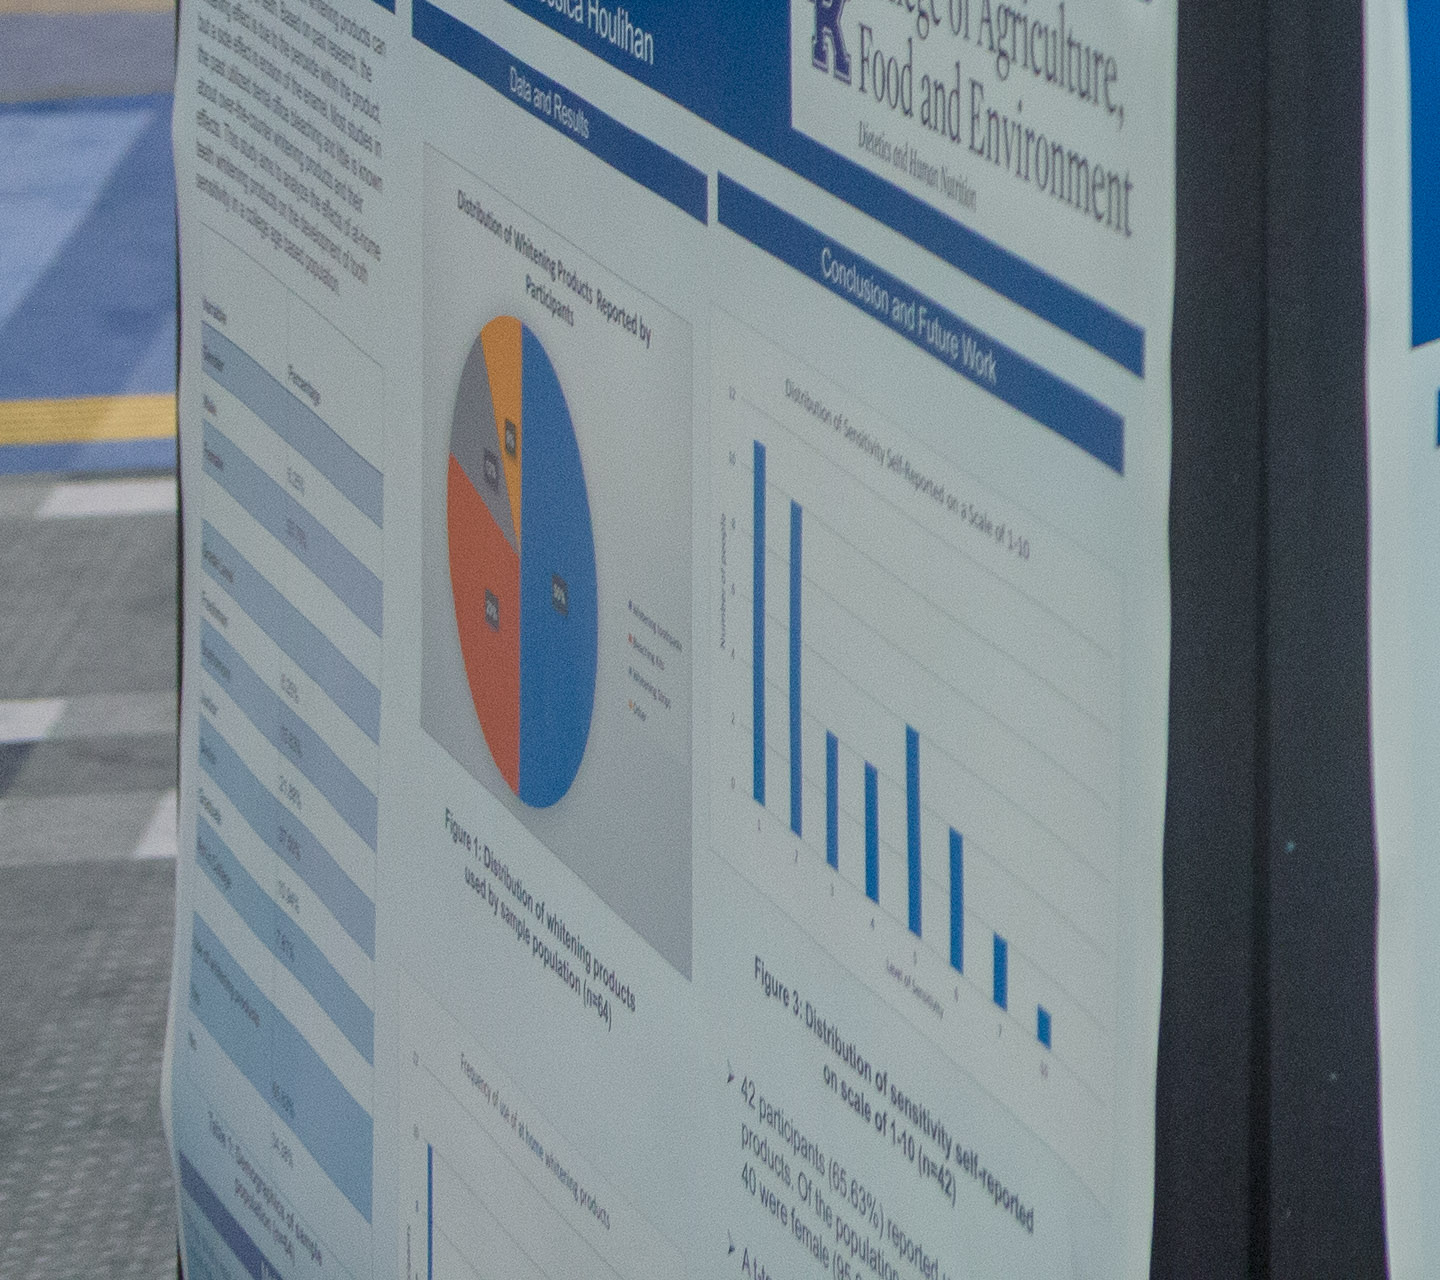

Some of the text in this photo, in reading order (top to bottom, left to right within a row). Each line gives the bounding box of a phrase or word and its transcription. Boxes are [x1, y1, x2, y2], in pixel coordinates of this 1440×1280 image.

[509, 65, 590, 140] Data and Results
[857, 21, 1134, 239] Food and Environment
[821, 246, 997, 384] Conclusion and Future Work
